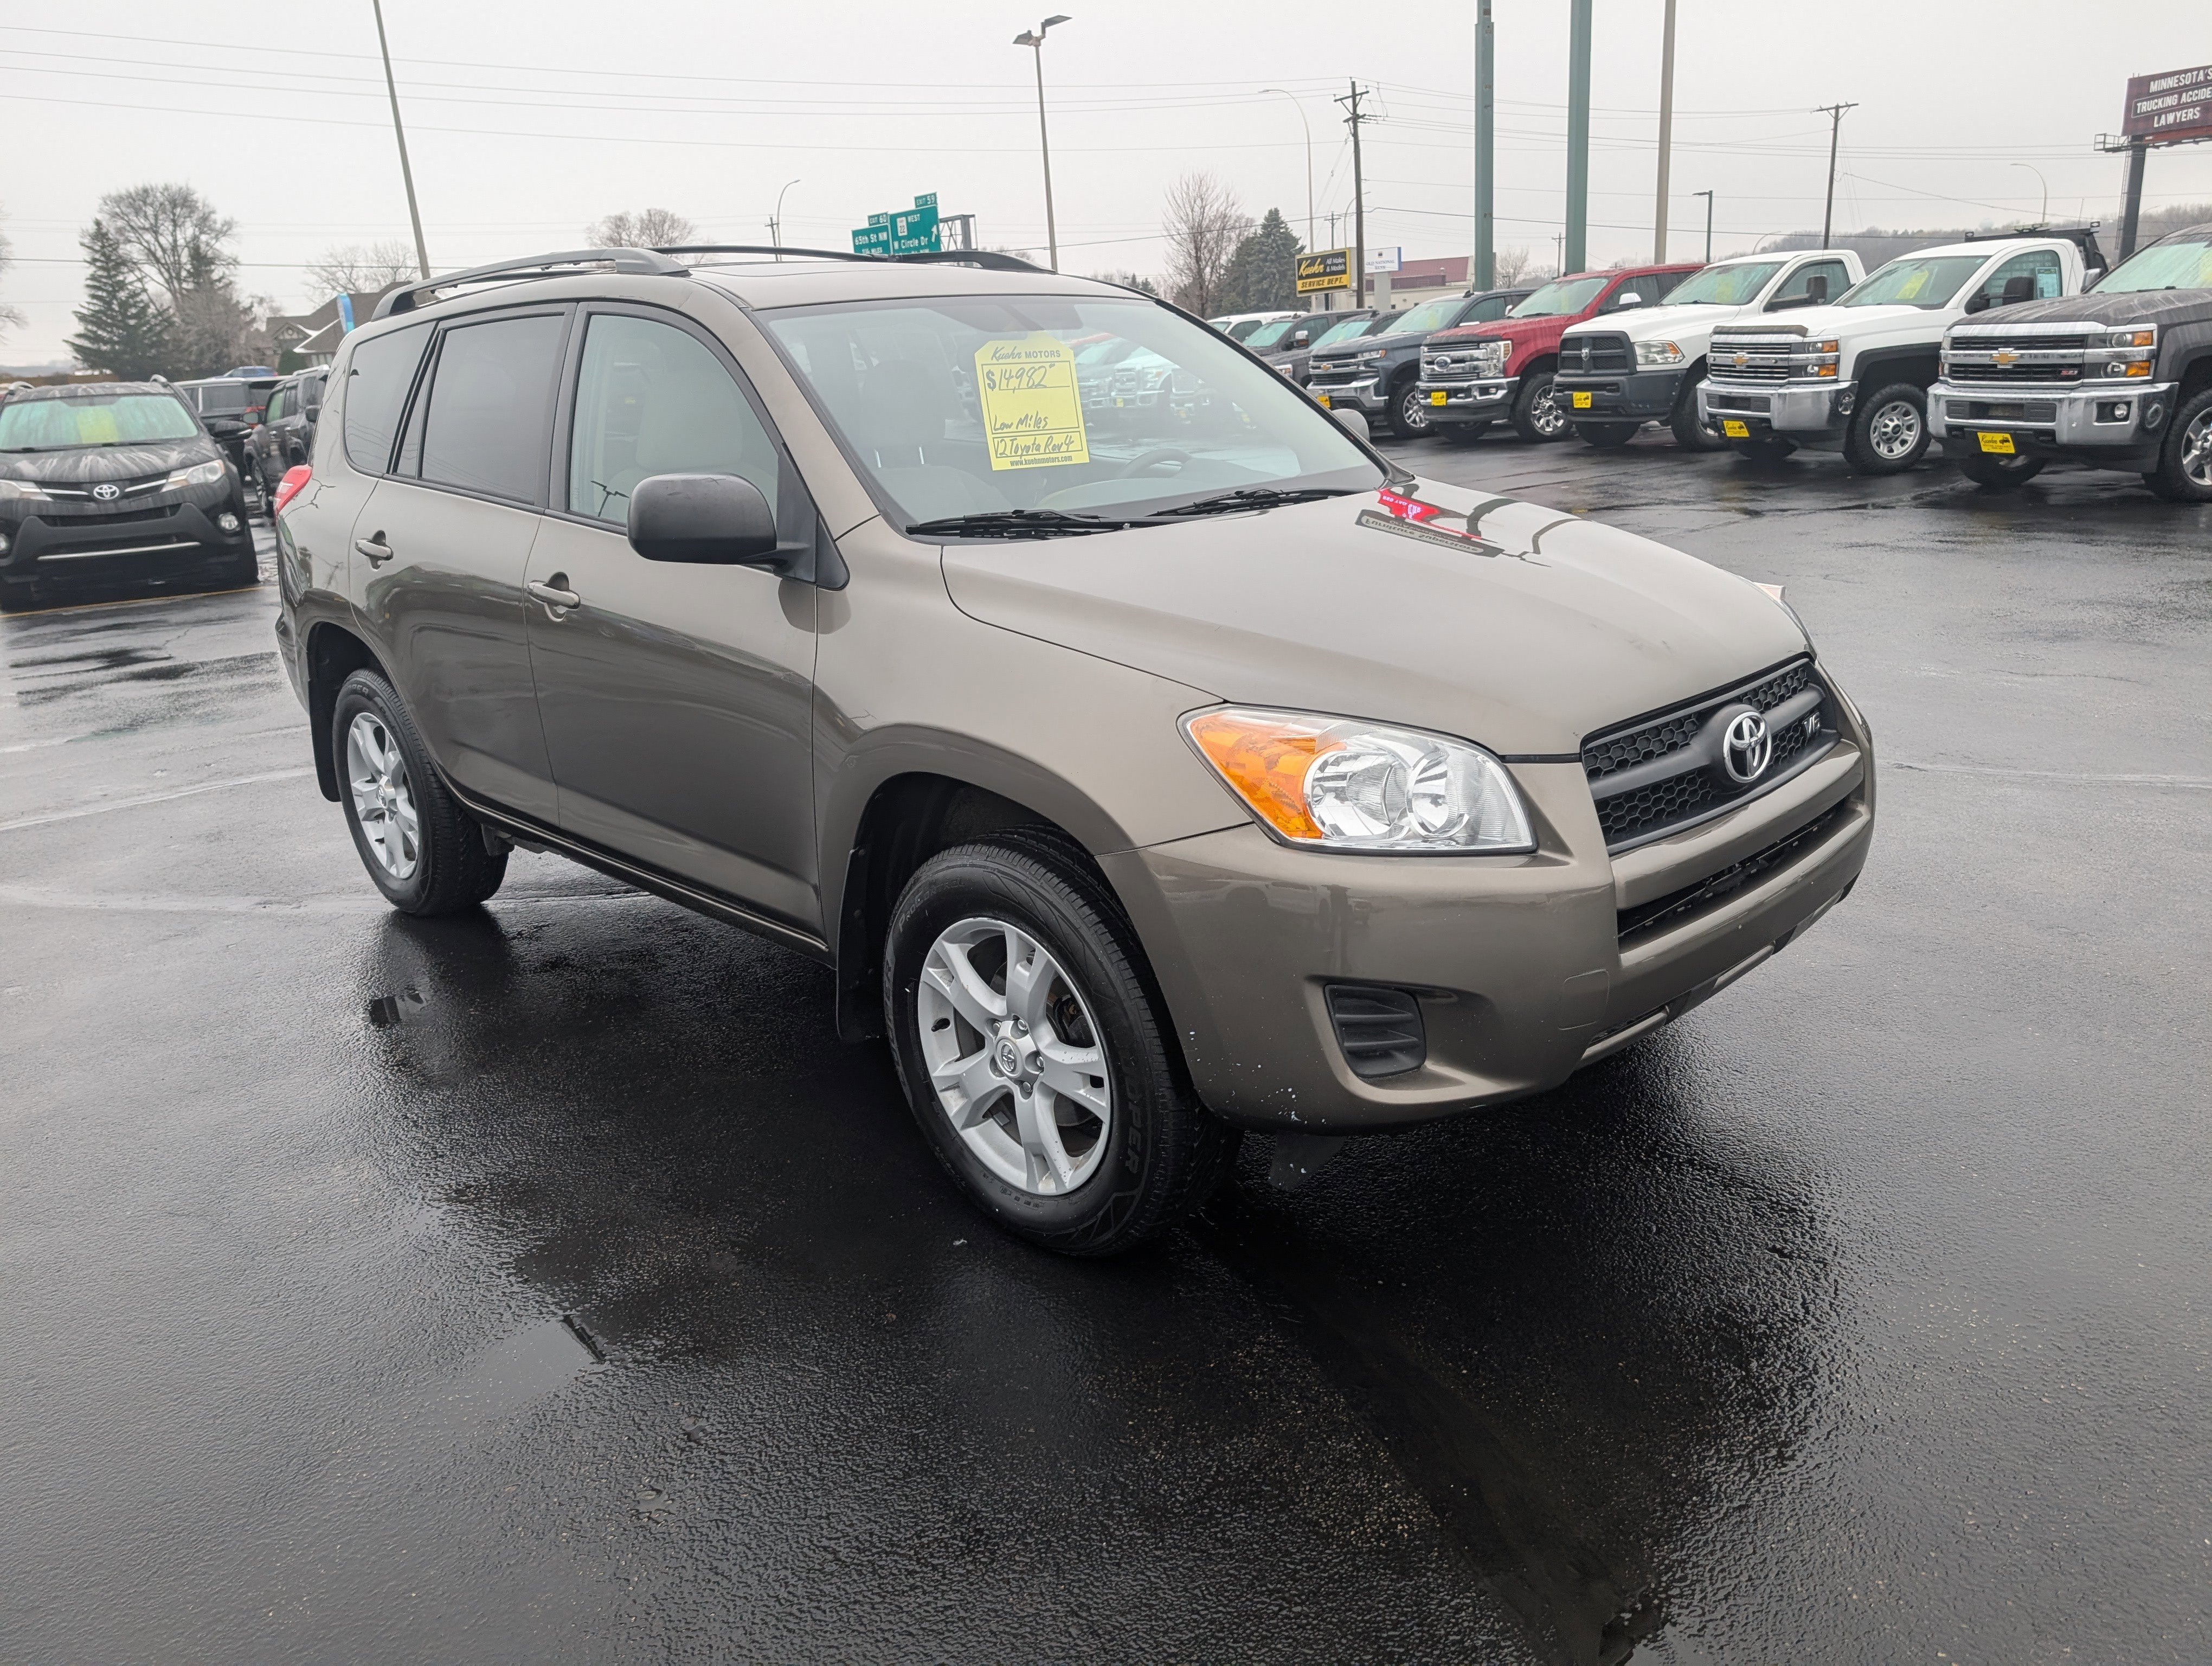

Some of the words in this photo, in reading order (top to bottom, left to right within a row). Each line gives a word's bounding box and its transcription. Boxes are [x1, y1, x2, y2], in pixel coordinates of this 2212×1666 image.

[2149, 68, 2212, 93] MINNESOTA'S
[2137, 94, 2178, 113] TRUCKING
[2153, 107, 2201, 128] LAWYERS
[927, 195, 935, 204] 59
[879, 214, 887, 223] 60
[907, 214, 921, 222] WEST
[901, 238, 919, 249] Circle
[920, 235, 928, 246] Dr
[1298, 258, 1324, 277] Kuehn
[1302, 279, 1325, 288] SERVICE
[991, 346, 1022, 362] Kuehn
[1025, 350, 1061, 359] MOTORS
[993, 414, 1014, 431] Low
[1015, 410, 1049, 430] Miles
[1009, 437, 1041, 460] Toyota
[1009, 455, 1073, 467] www.kuehnmotors.com
